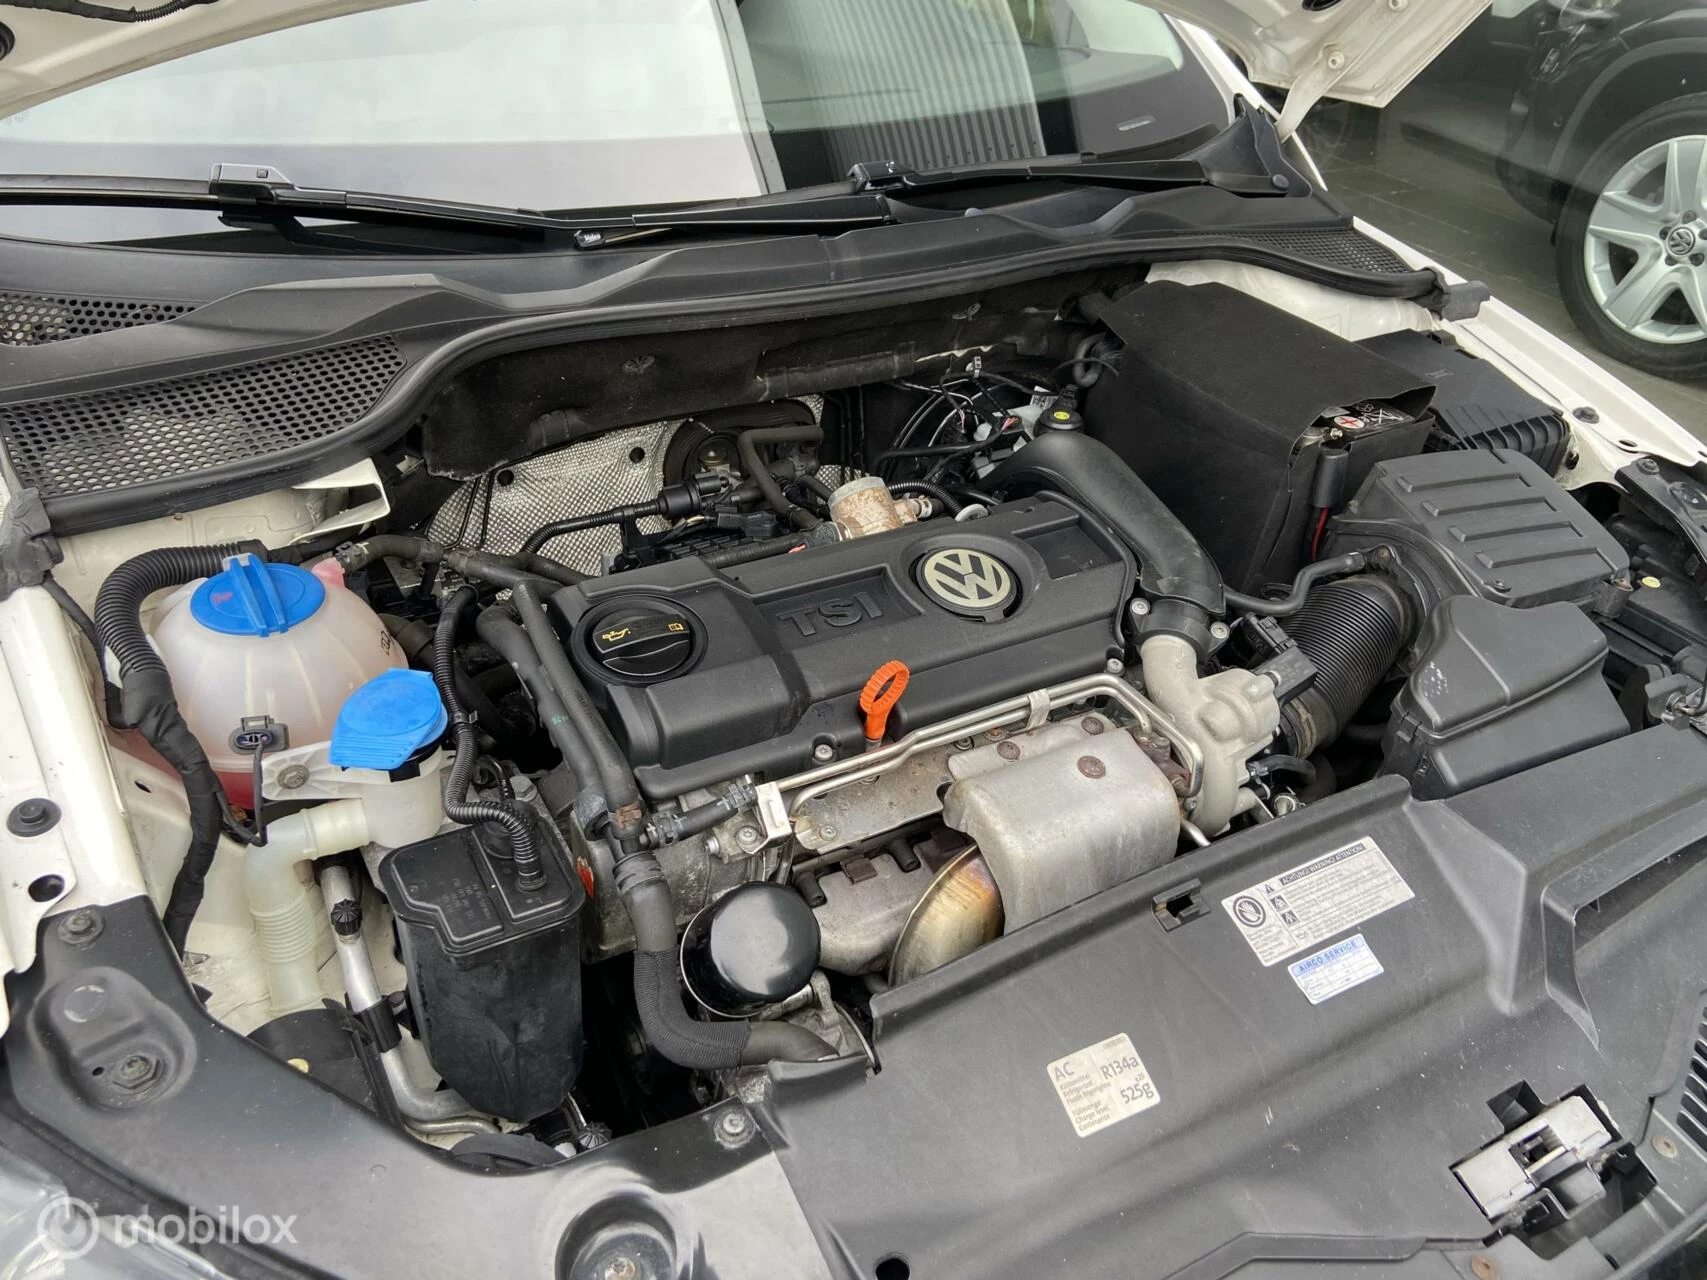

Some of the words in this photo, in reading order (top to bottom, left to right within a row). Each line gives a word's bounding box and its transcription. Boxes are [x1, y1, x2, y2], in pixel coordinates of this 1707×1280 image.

[777, 591, 883, 637] TSI
[1299, 956, 1323, 972] AIRCO
[1323, 940, 1357, 960] SERVICE
[1054, 1062, 1075, 1081] AC
[1100, 1056, 1139, 1080] R134a
[1120, 1082, 1154, 1105] 525g
